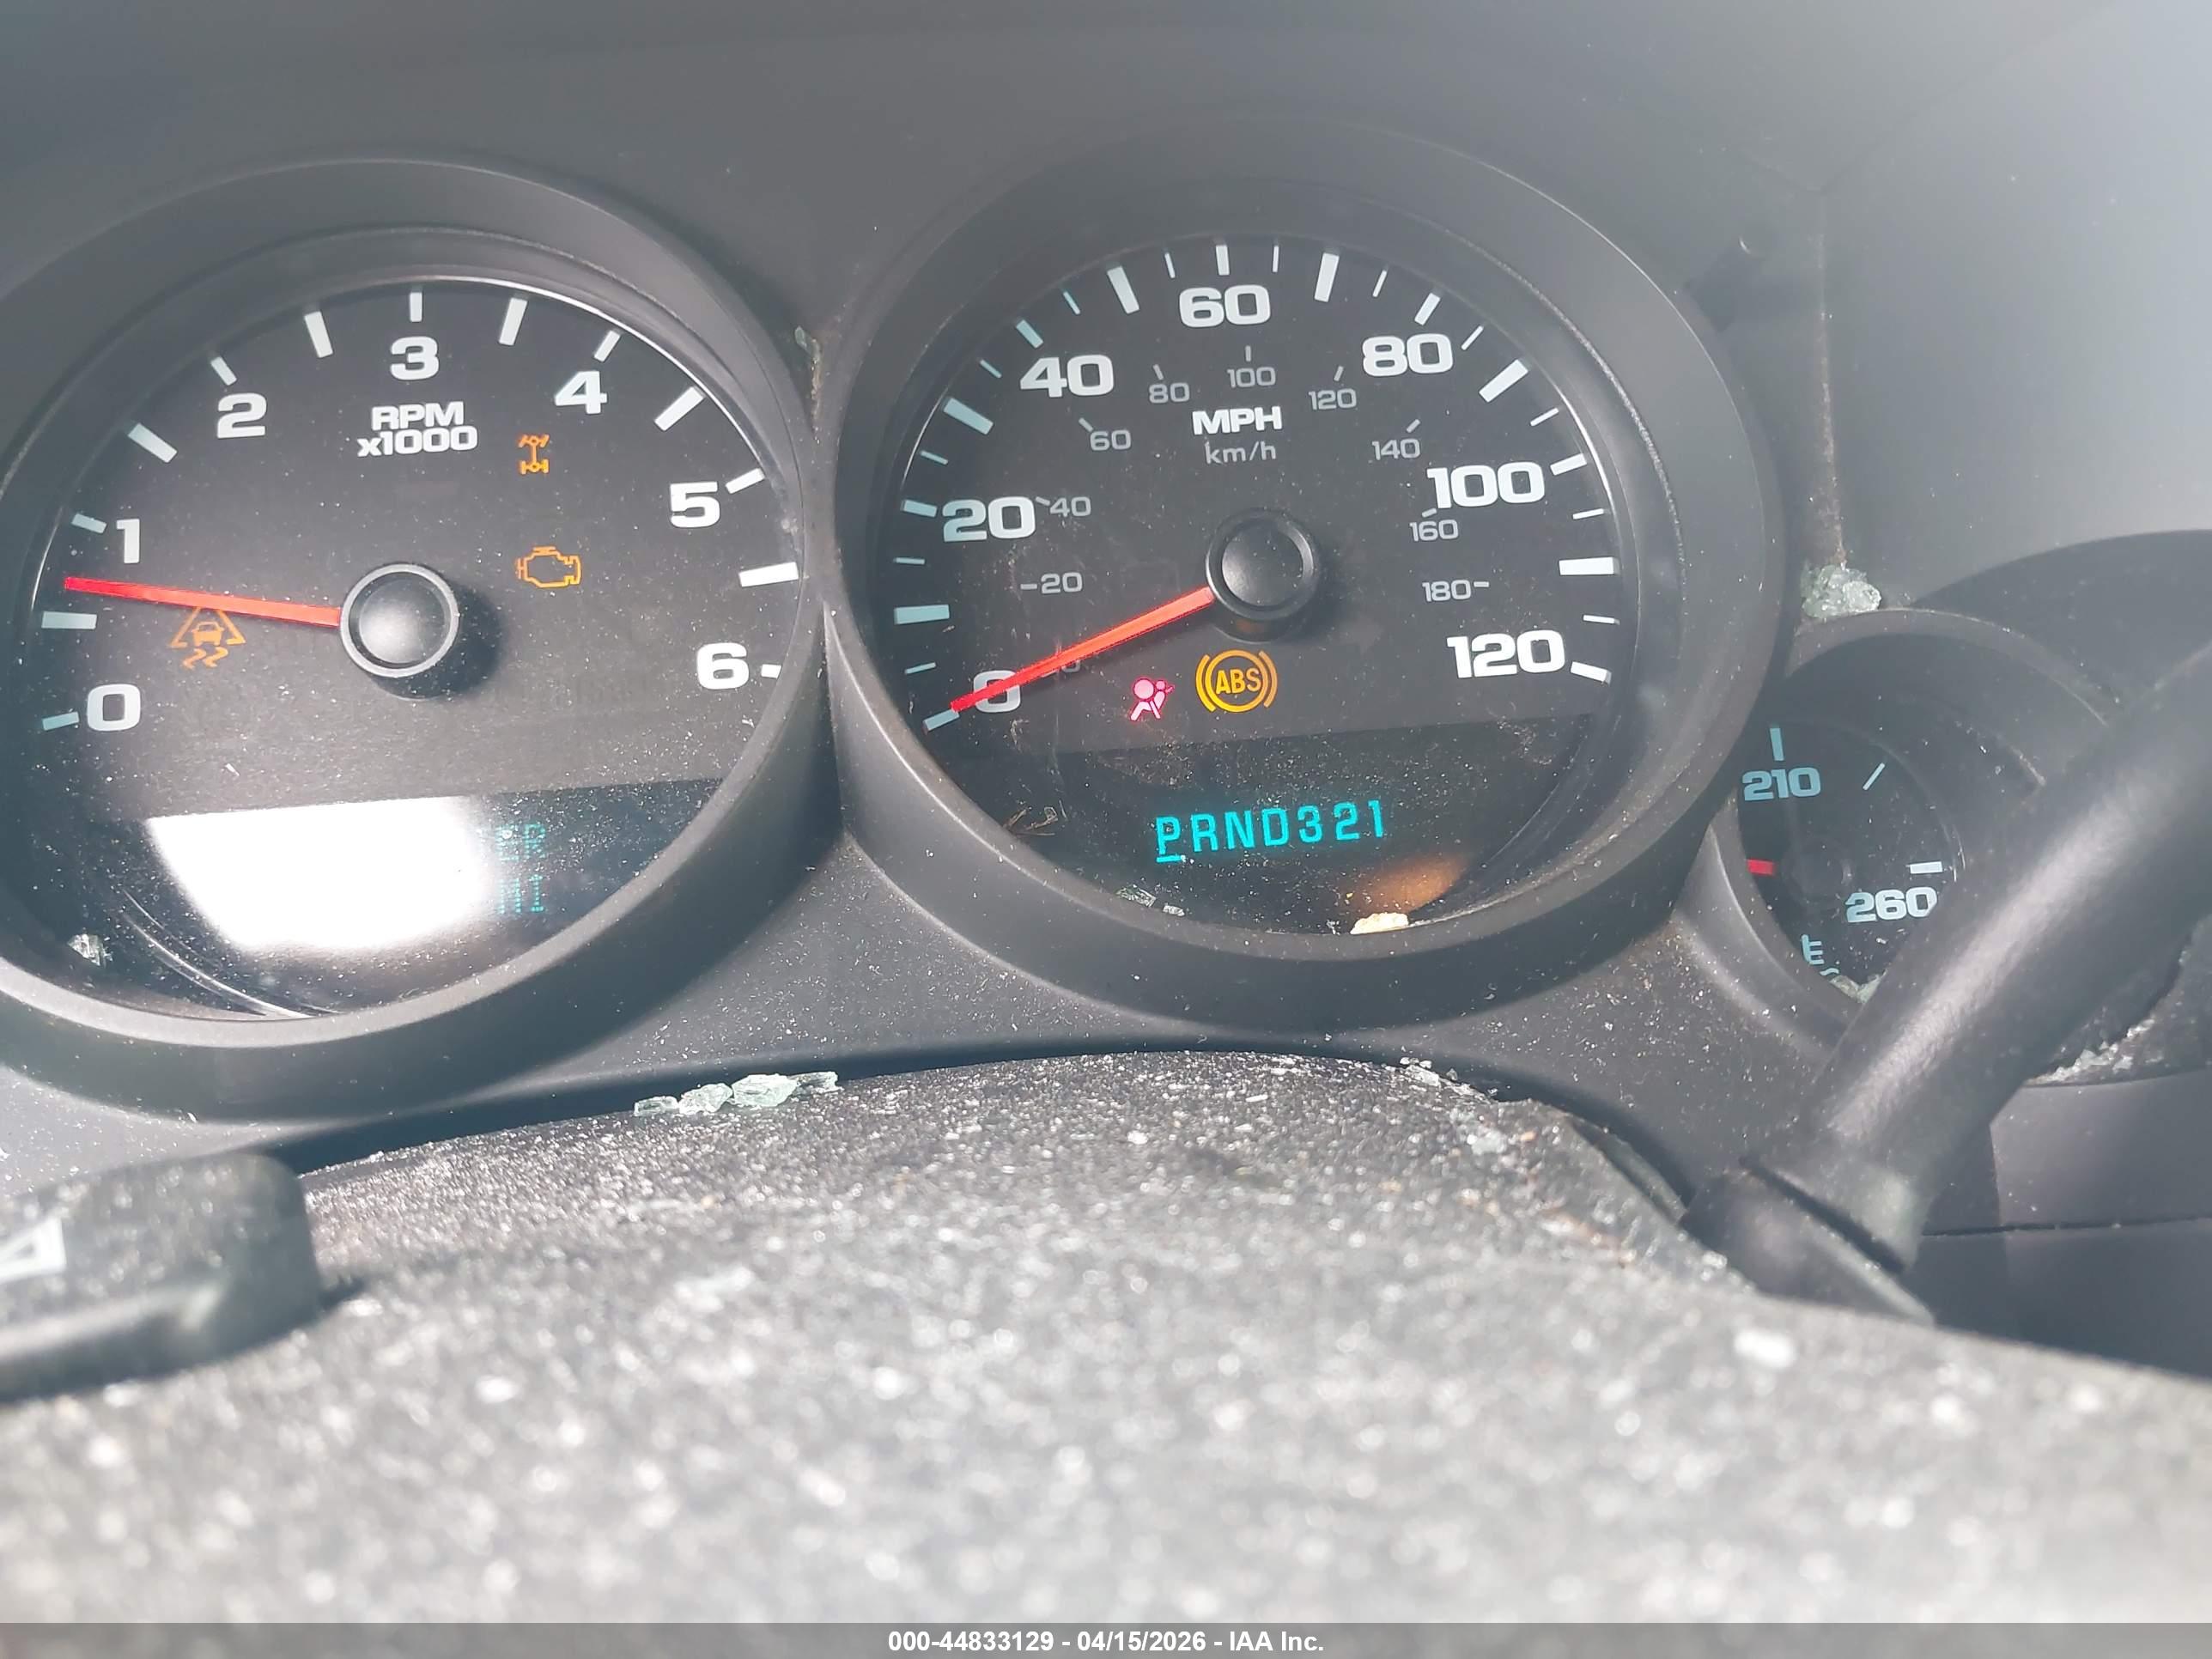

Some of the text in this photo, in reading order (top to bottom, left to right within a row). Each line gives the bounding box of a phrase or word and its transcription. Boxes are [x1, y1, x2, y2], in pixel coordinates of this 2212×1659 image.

[1179, 284, 1271, 328] 60
[390, 336, 439, 380] 3
[1362, 333, 1453, 377] 80
[555, 370, 607, 414] 4
[1019, 354, 1114, 398] 40
[1149, 382, 1190, 404] 80
[1227, 367, 1276, 388] 100
[217, 392, 267, 438] 2
[372, 401, 464, 430] RPM
[1309, 388, 1357, 410] 120
[1192, 406, 1282, 435] MPH
[357, 425, 477, 457] x1000
[1090, 429, 1132, 452] 60
[1205, 441, 1276, 465] km/h
[1372, 439, 1420, 460] 140
[1426, 461, 1545, 508] 100
[670, 481, 720, 528] 5
[942, 496, 1036, 543] 20
[1049, 496, 1091, 517] 40
[117, 519, 140, 563] 1
[1409, 520, 1459, 542] 160
[1040, 572, 1085, 594] 20
[1422, 580, 1471, 602] 180
[696, 641, 750, 690] 6
[1446, 629, 1565, 678] 120
[973, 670, 1021, 713] 0
[1216, 668, 1261, 694] ABS
[87, 684, 141, 731] 0
[1742, 768, 1820, 800] 210
[1845, 887, 1937, 923] 260
